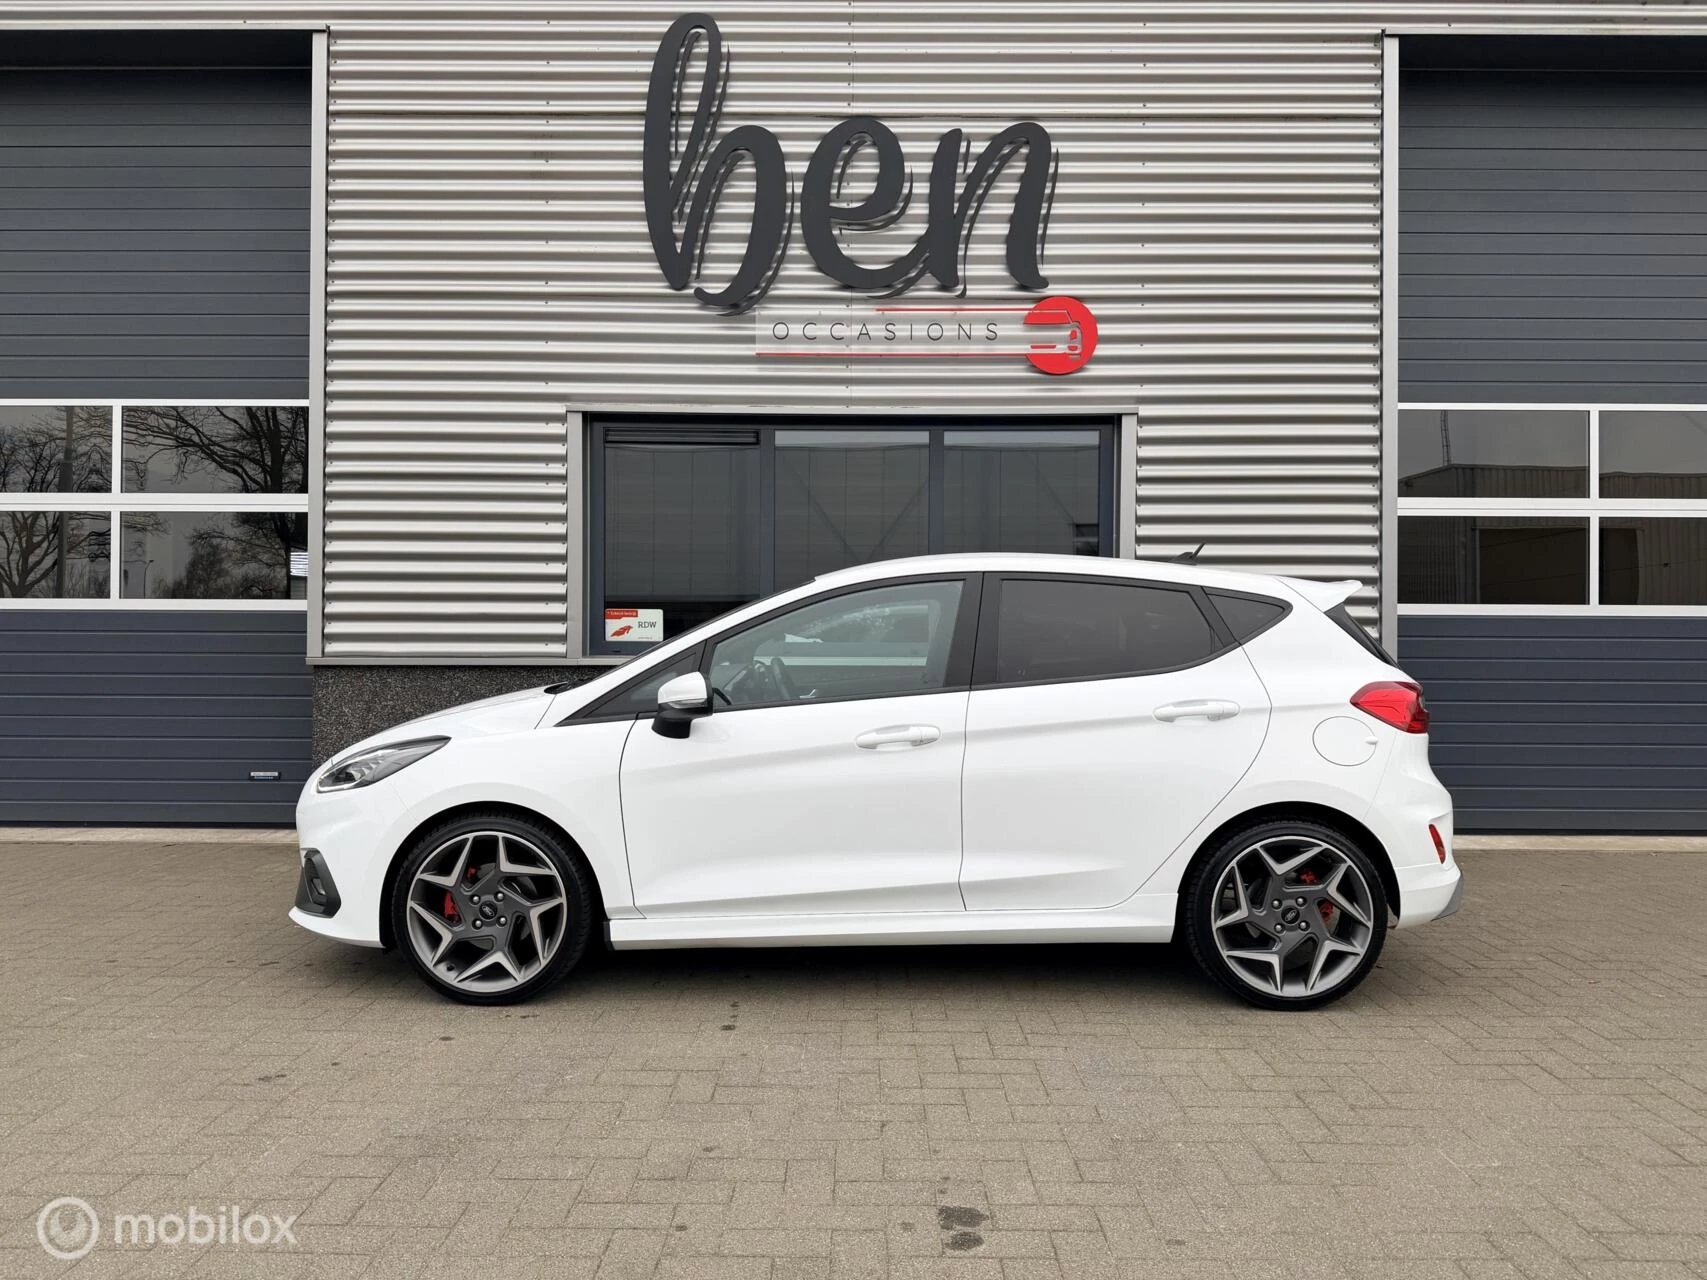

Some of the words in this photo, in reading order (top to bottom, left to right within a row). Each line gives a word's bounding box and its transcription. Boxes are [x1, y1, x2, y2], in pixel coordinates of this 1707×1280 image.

[643, 12, 1050, 307] ben
[772, 322, 998, 341] OCCASIONS
[637, 621, 657, 629] RDW
